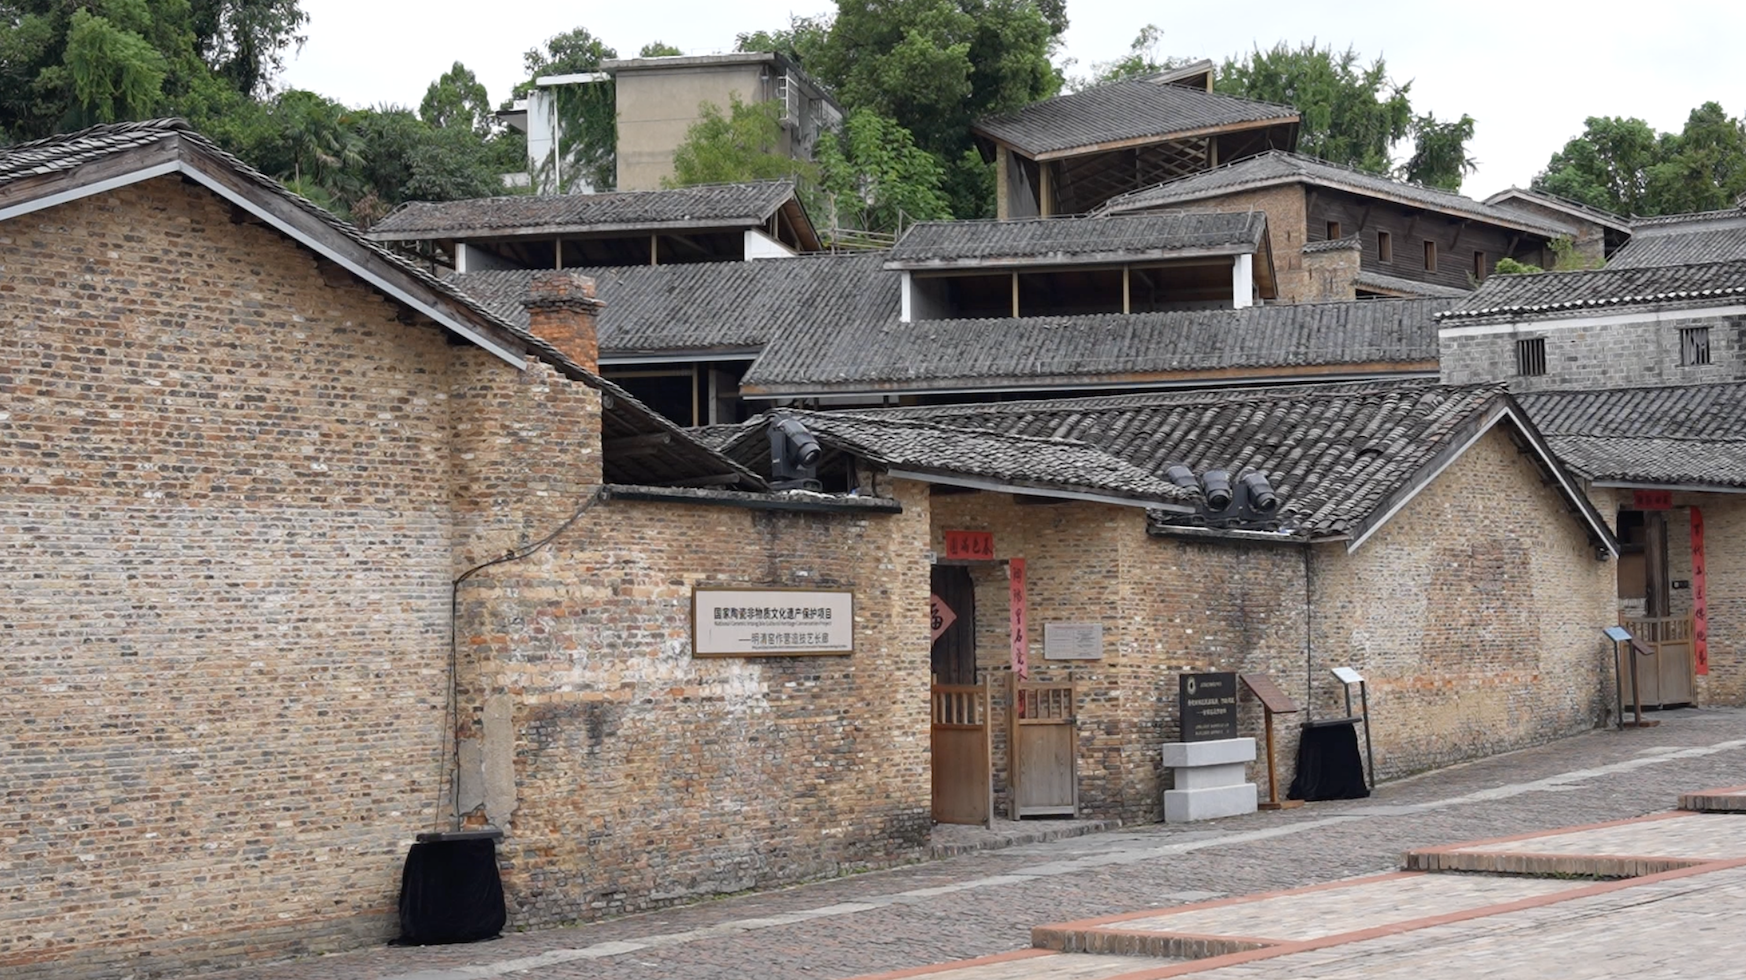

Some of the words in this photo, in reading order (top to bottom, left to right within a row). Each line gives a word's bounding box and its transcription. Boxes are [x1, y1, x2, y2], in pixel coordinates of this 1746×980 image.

[714, 607, 832, 620] 国家陶瓷非物质文化遗产保护项目
